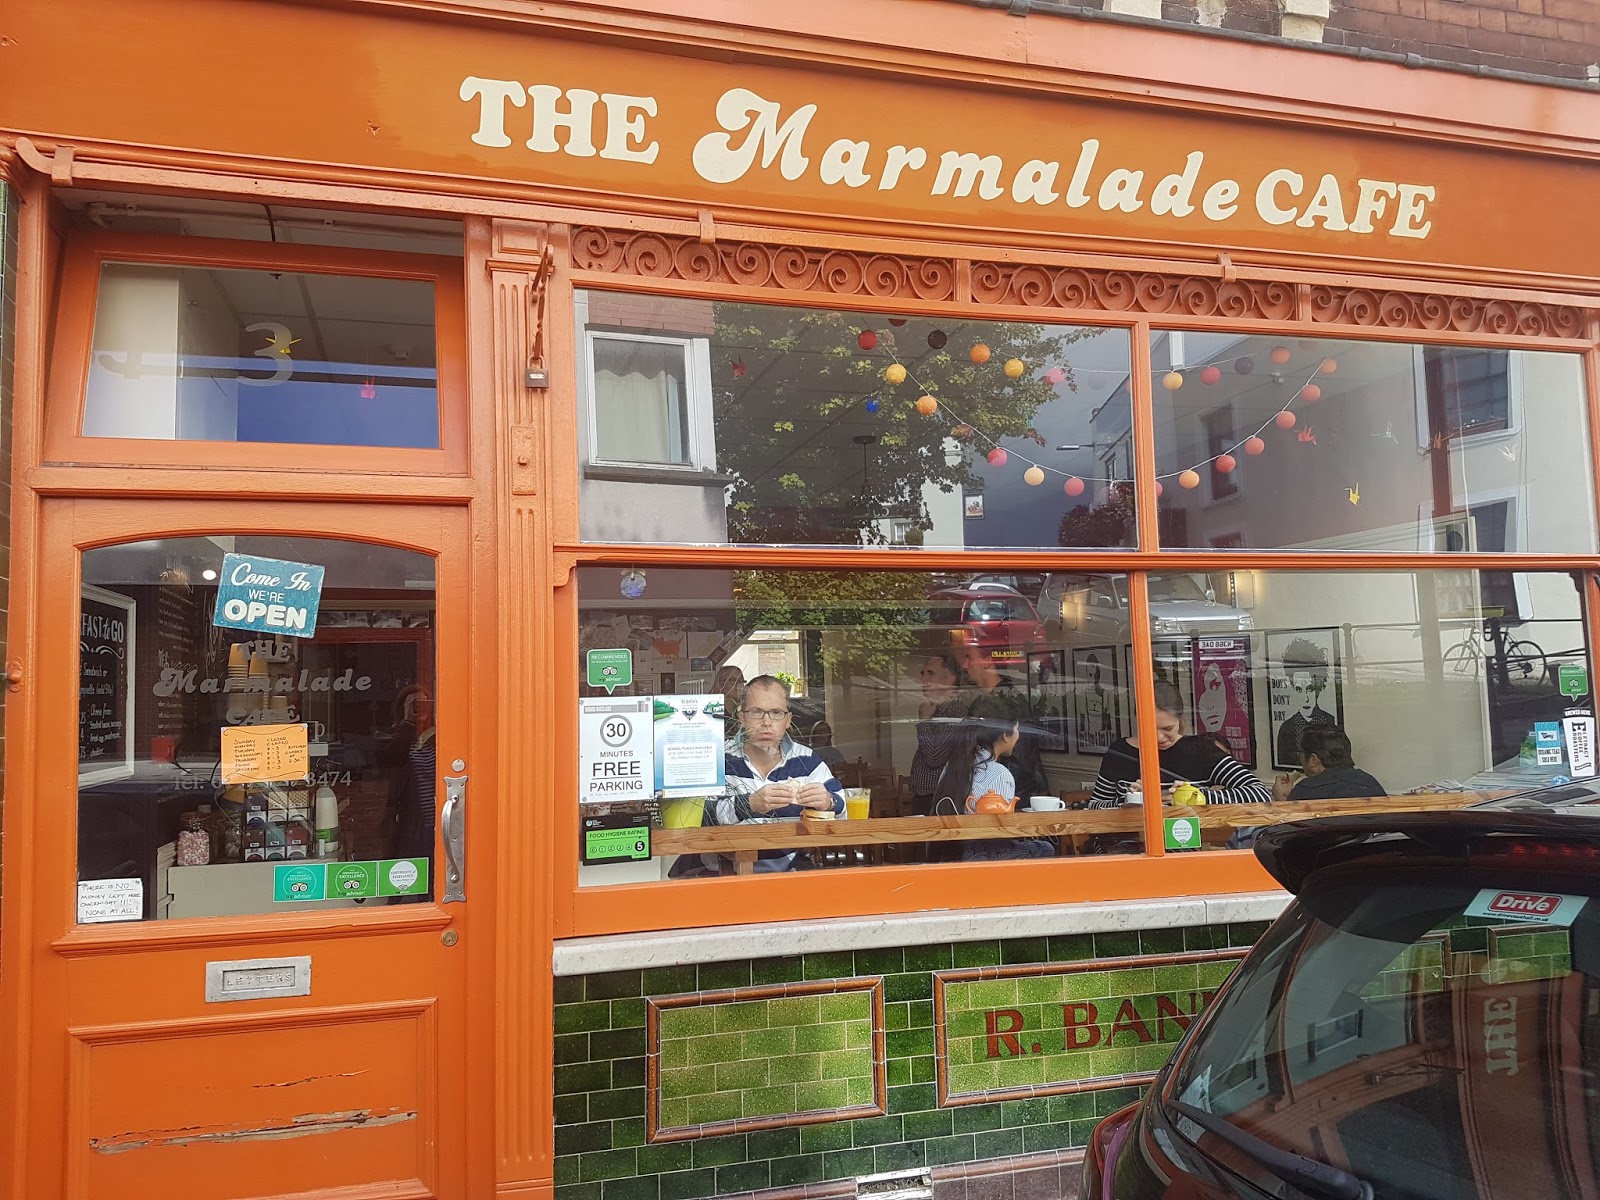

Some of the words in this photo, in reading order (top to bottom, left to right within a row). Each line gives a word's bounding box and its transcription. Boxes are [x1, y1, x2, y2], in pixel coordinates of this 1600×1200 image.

[459, 76, 658, 166] THE
[692, 86, 1239, 220] Marmalade
[1254, 167, 1436, 240] CAFE
[236, 322, 294, 387] 3
[231, 562, 280, 587] Come
[284, 571, 312, 591] In
[248, 588, 285, 604] WE'RE
[224, 599, 308, 630] OPEN
[80, 612, 103, 639] FAST
[111, 619, 124, 644] GO
[238, 639, 292, 662] THE
[152, 667, 372, 697] Marmalade
[1271, 678, 1288, 689] BOYS
[226, 704, 300, 726] CAFE
[606, 722, 627, 739] 30
[600, 750, 634, 758] MINUTES
[1572, 731, 1580, 763] ROASTERS
[592, 760, 641, 777] FREE
[171, 775, 204, 790] Tel.
[589, 780, 644, 792] PARKING
[637, 842, 643, 851] 5
[1497, 895, 1550, 912] Drive
[85, 909, 107, 917] NONE
[226, 972, 292, 986] LETTERS
[985, 1009, 1042, 1059] R.
[1060, 991, 1217, 1051] BAN
